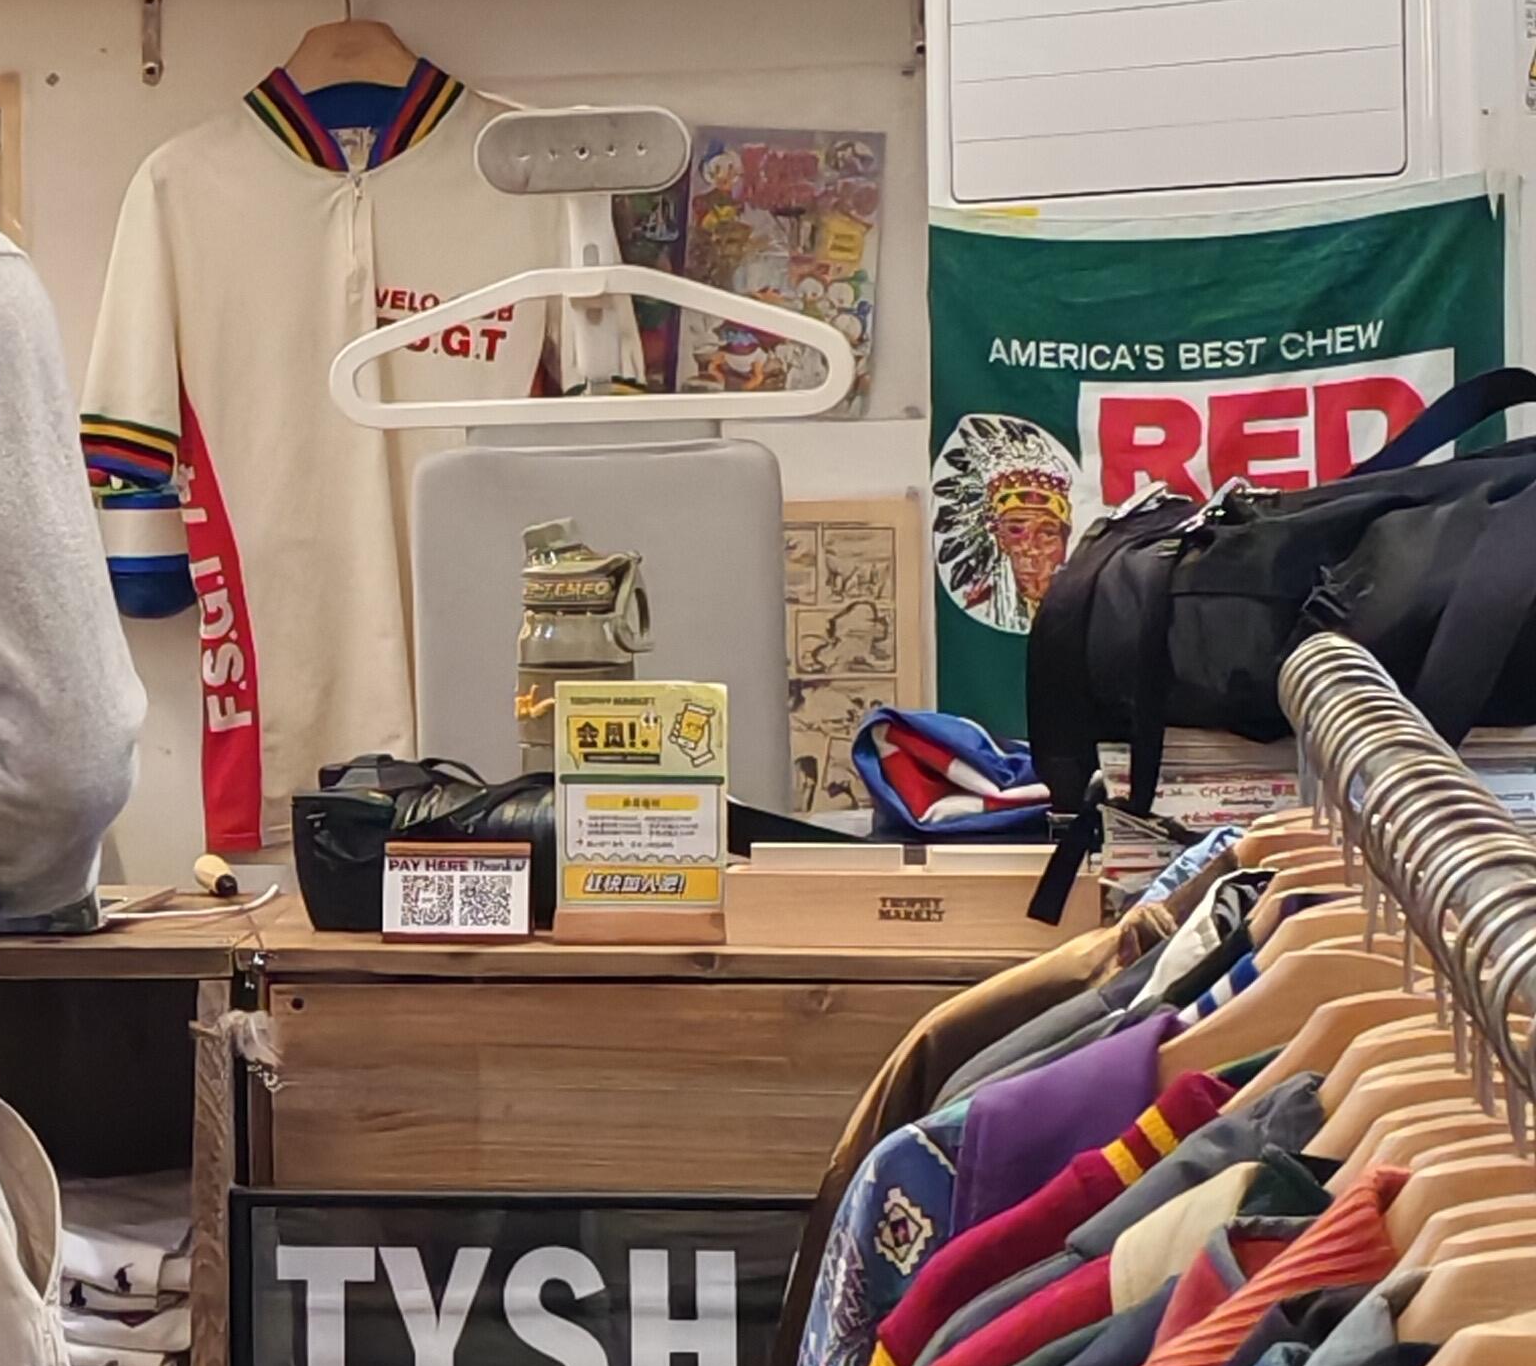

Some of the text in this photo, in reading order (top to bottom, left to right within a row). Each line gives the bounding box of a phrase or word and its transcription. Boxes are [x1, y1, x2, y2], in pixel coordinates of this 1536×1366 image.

[989, 320, 1384, 371] AMERICA'S BEST CHEW
[1099, 376, 1427, 507] RED
[389, 859, 421, 871] PAY
[425, 859, 468, 871] HERE
